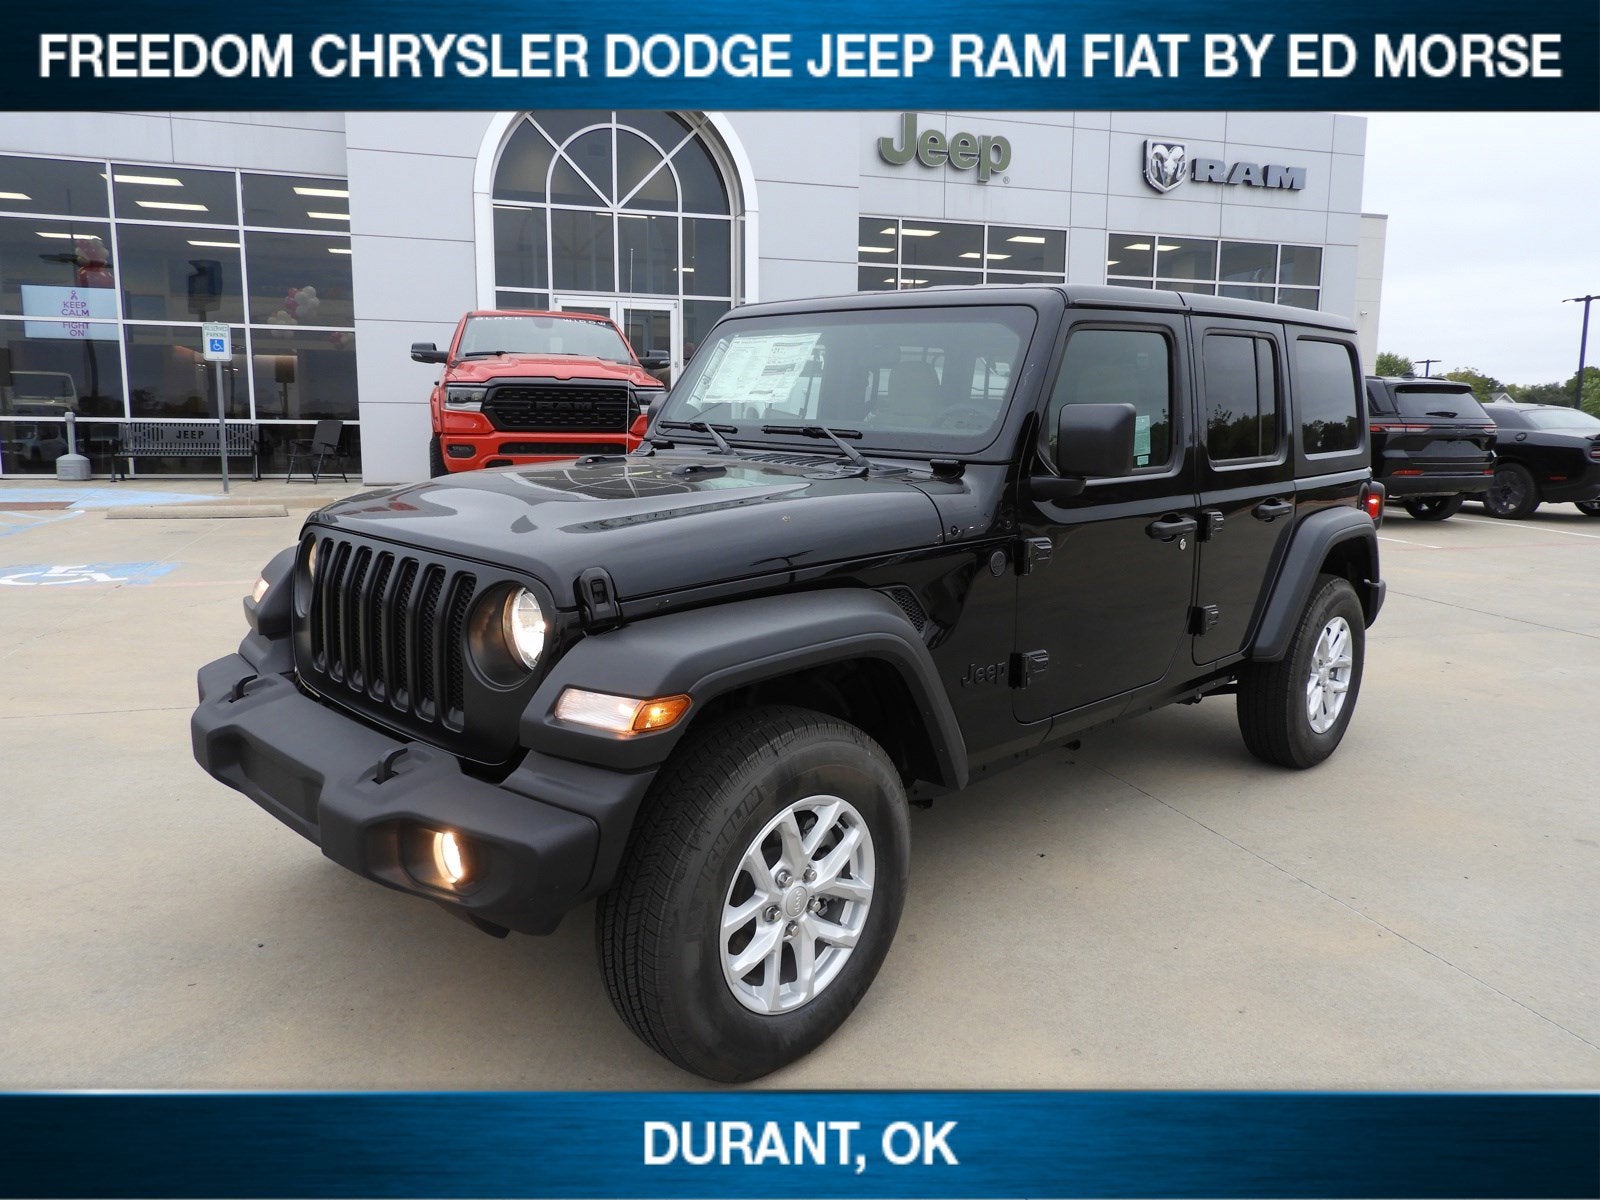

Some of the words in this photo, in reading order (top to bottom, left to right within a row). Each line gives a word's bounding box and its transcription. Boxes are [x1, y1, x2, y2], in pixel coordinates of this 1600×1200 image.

[878, 112, 1011, 182] Jeep
[1191, 158, 1307, 190] RAM
[63, 301, 87, 309] KEEP
[61, 309, 90, 317] CALM
[70, 329, 85, 337] ON
[175, 430, 205, 440] JEEP
[961, 662, 1006, 689] Jeep
